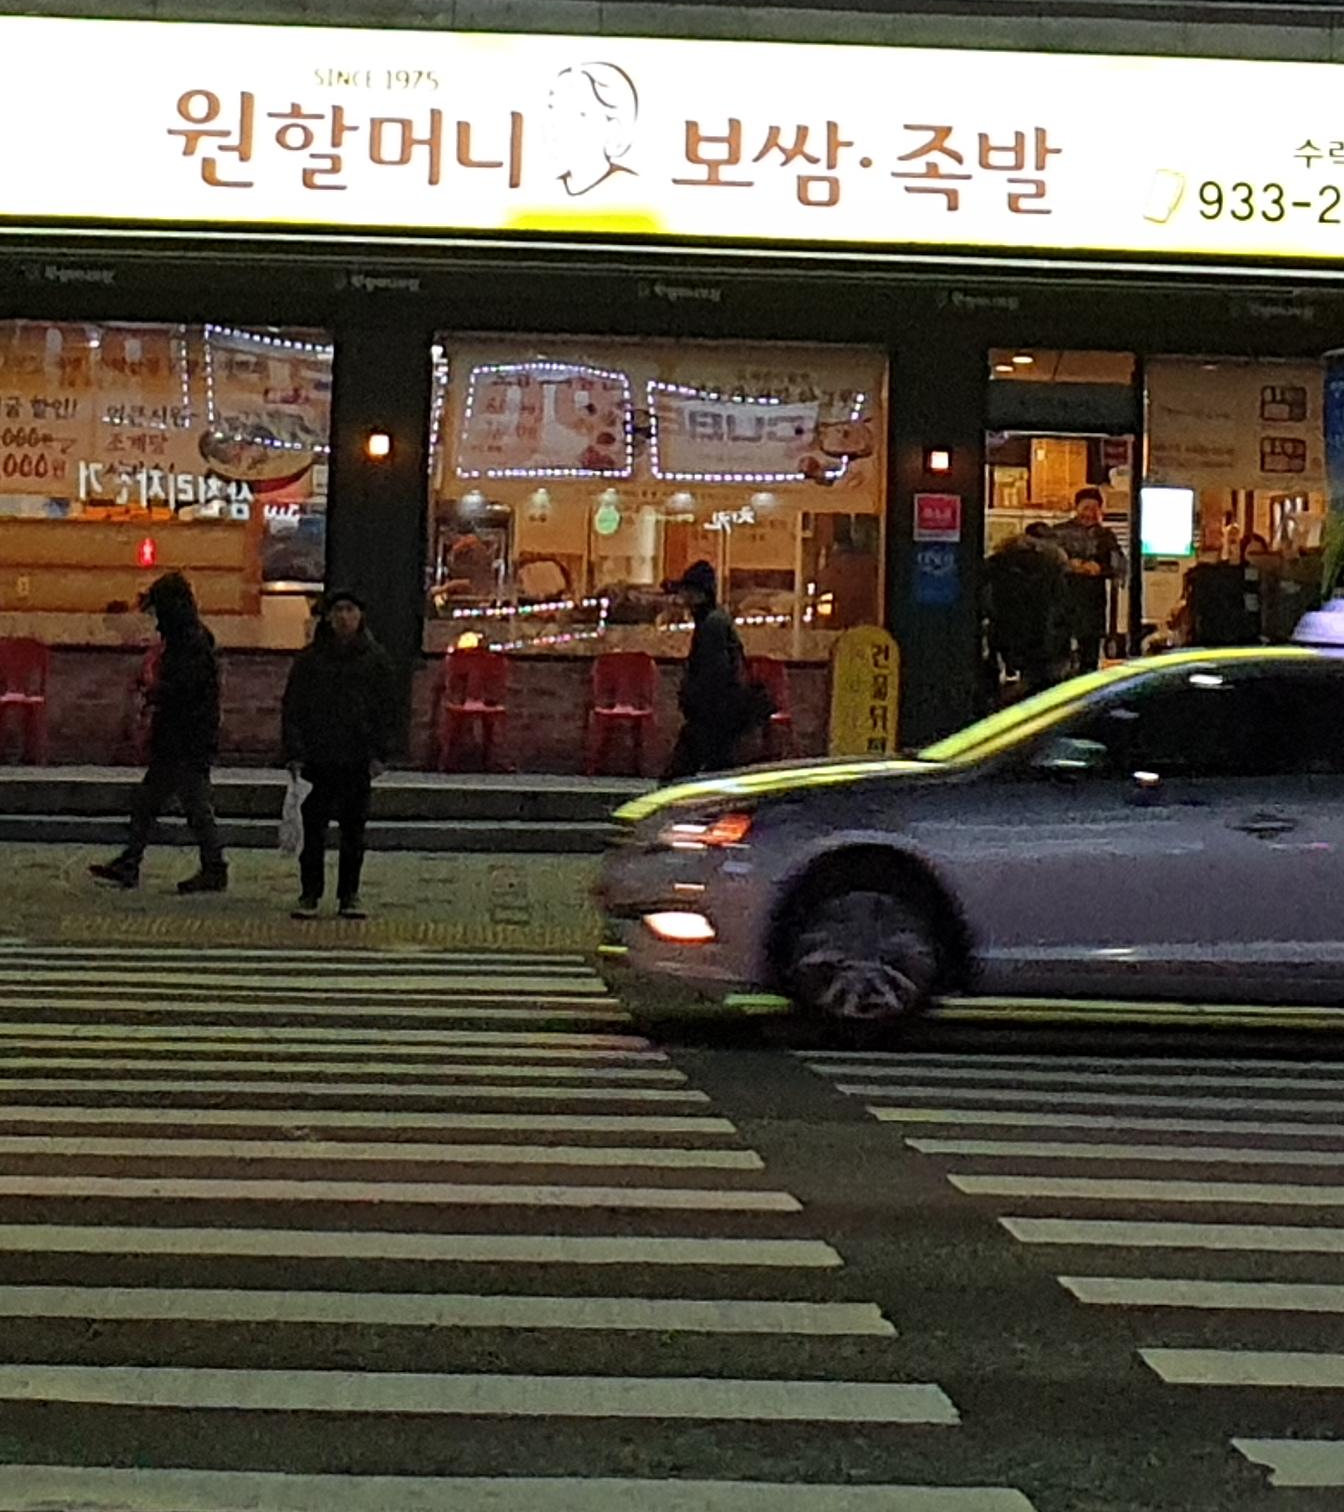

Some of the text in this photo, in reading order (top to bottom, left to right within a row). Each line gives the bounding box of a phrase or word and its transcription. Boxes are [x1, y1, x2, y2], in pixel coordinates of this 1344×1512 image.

[314, 67, 440, 91] SINCE 1975
[166, 88, 1063, 216] 원할머니 보쌈·족발
